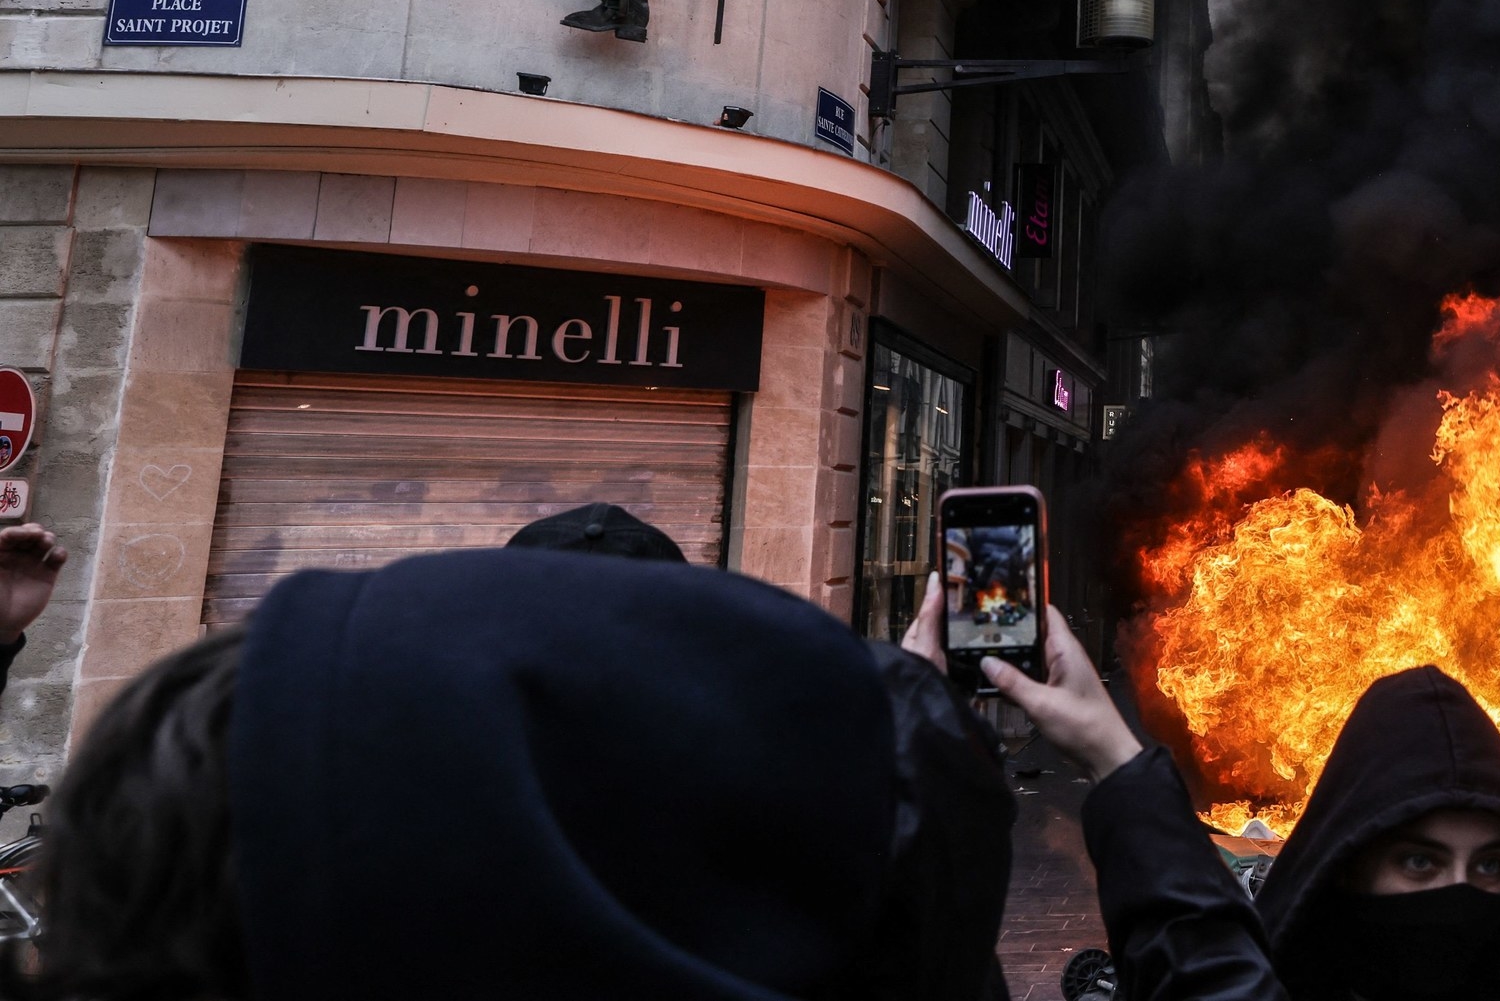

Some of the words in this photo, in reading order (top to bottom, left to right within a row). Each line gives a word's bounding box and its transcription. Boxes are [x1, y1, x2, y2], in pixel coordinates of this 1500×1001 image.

[115, 18, 166, 33] SAINT
[170, 19, 233, 36] PROJET
[835, 105, 845, 121] RUE
[817, 116, 835, 134] SAINTE
[966, 181, 1015, 270] minelli
[355, 285, 684, 368] minelli
